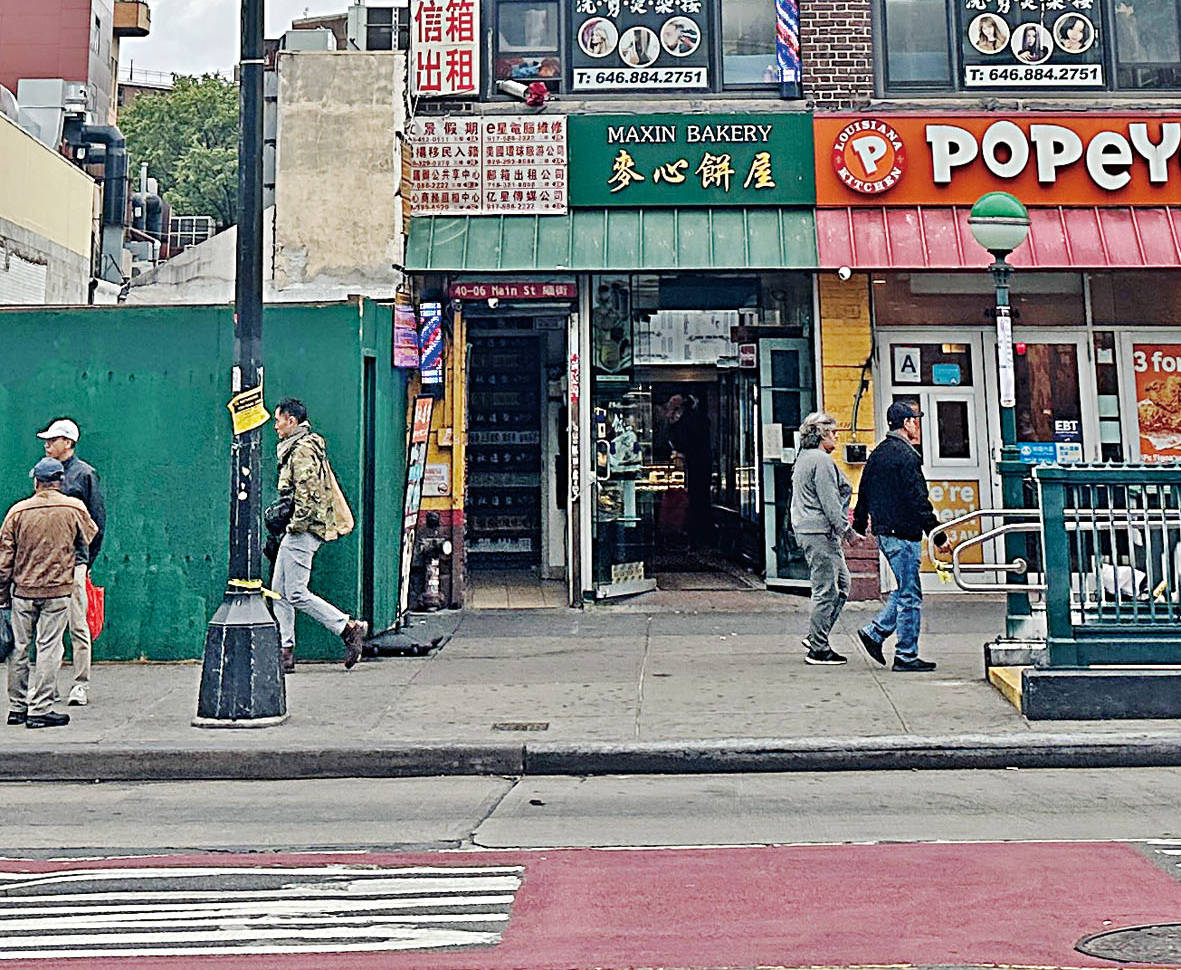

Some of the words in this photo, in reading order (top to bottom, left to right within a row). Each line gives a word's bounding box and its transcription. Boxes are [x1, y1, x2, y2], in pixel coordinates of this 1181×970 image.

[416, 48, 475, 92] 出租
[577, 71, 591, 84] T:
[596, 70, 702, 85] 646.884.2751
[969, 69, 984, 81] T:
[989, 67, 1098, 81] 646.884.2751
[607, 125, 677, 143] MAXIN
[686, 124, 772, 142] BAKERY
[834, 119, 903, 152] LOUISIANA
[852, 135, 887, 175] P
[607, 149, 777, 193] 麥心餅屋
[837, 166, 902, 193] KITCHEN
[455, 285, 486, 296] 40-06
[491, 285, 518, 296] Main
[523, 285, 536, 296] St
[900, 354, 916, 373] A
[1133, 351, 1148, 372] 3
[1055, 420, 1078, 431] EBT
[929, 481, 974, 502] e're
